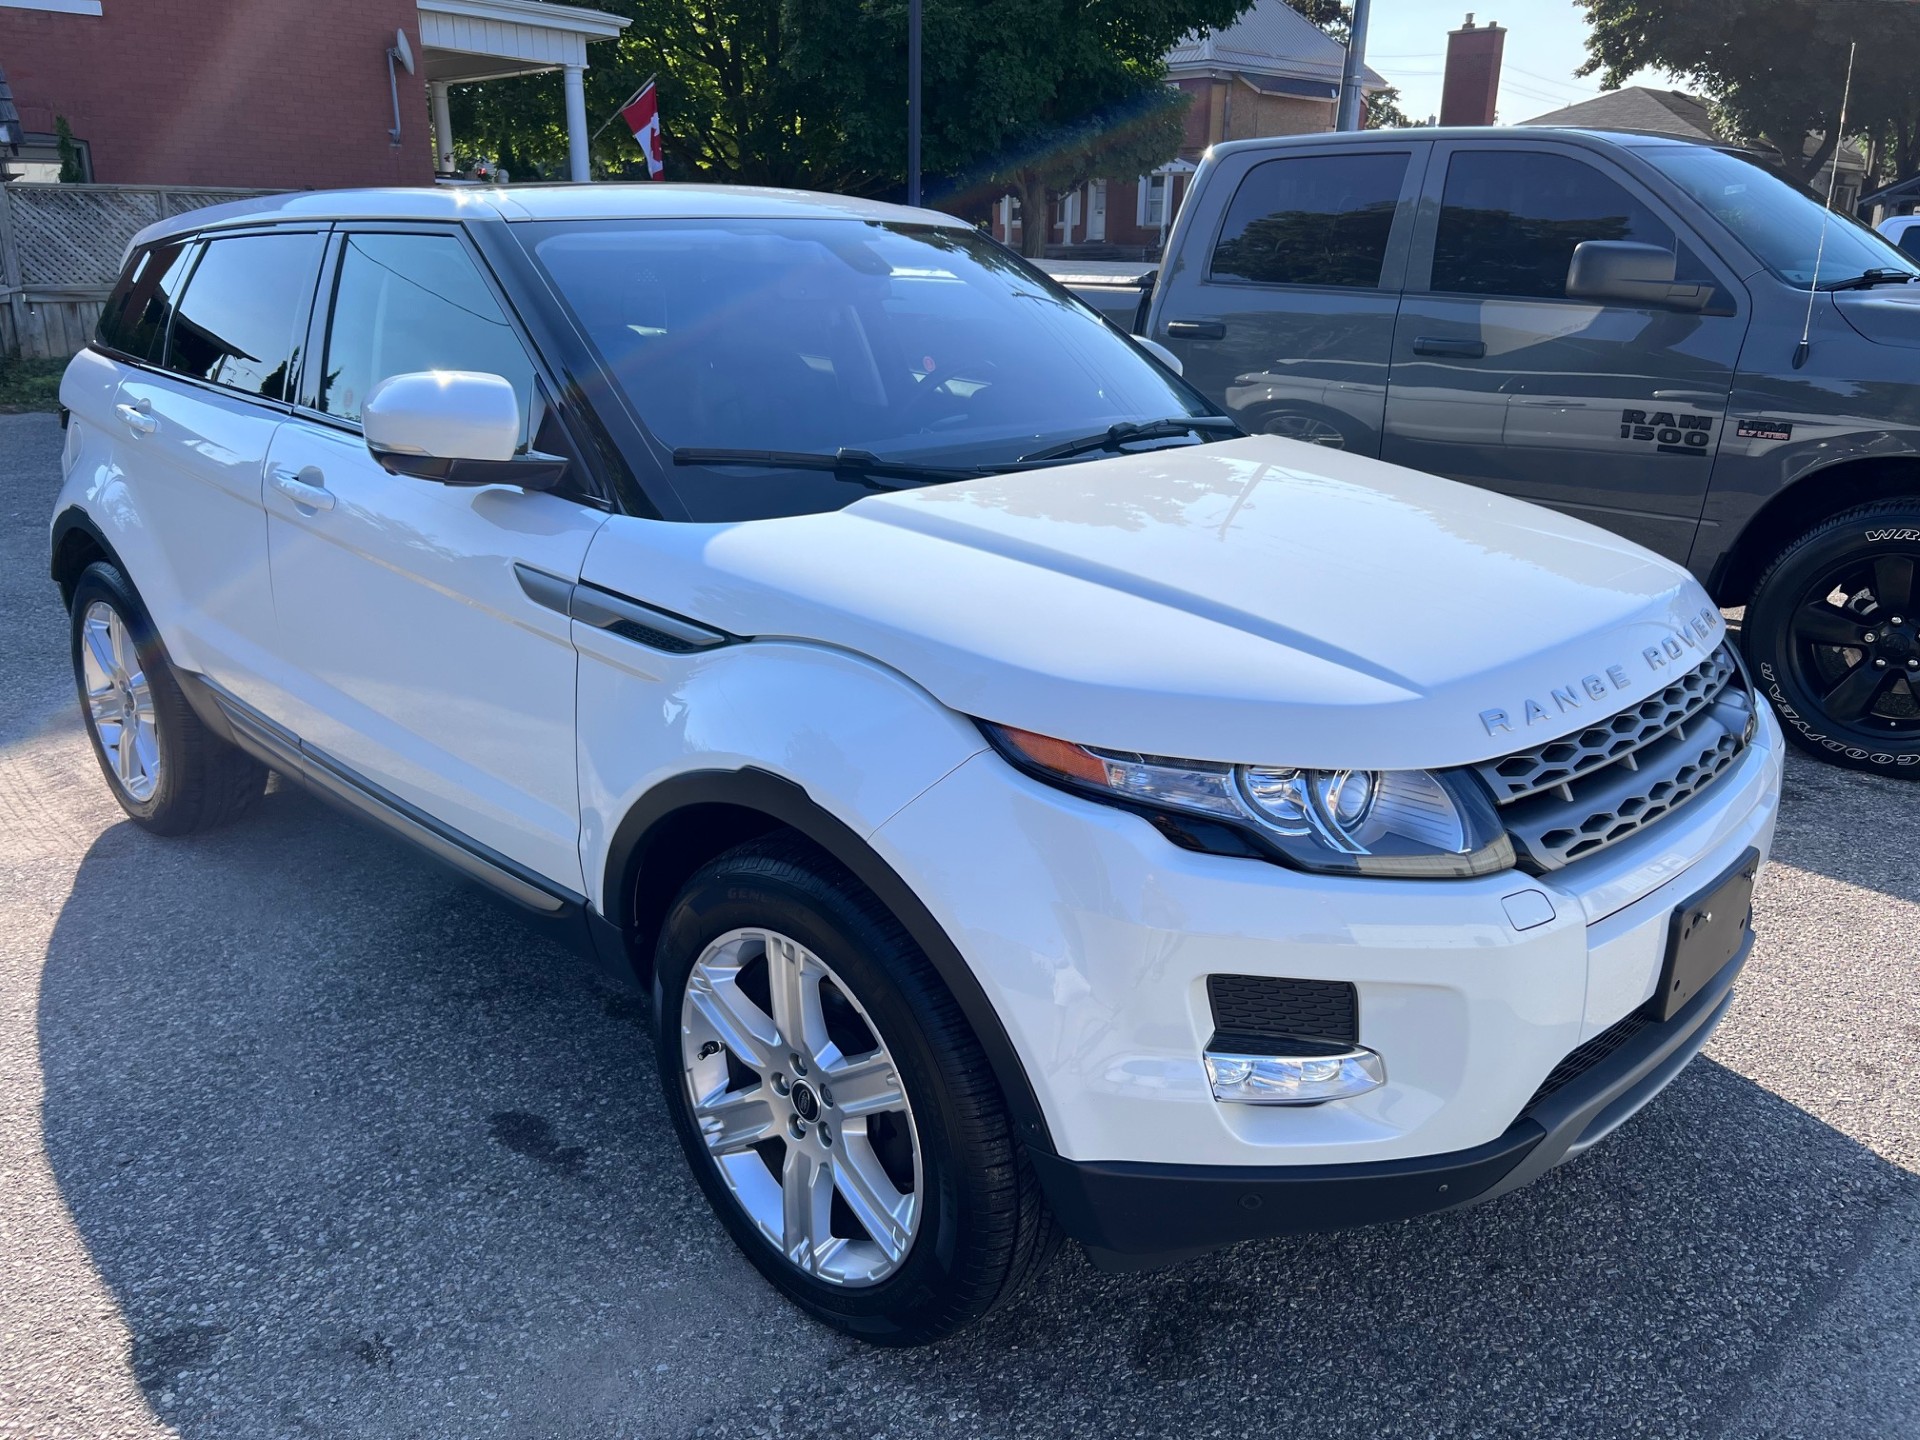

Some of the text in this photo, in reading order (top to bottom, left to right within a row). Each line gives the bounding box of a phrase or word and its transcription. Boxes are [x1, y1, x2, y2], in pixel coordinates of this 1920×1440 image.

[1621, 409, 1713, 431] RAM
[1738, 420, 1793, 434] HEMI
[1620, 424, 1710, 447] 1500
[1757, 430, 1789, 440] LITER
[1865, 528, 1920, 542] WR
[1478, 607, 1717, 737] RANGE ROVER
[1760, 662, 1920, 766] GOODYEAR
